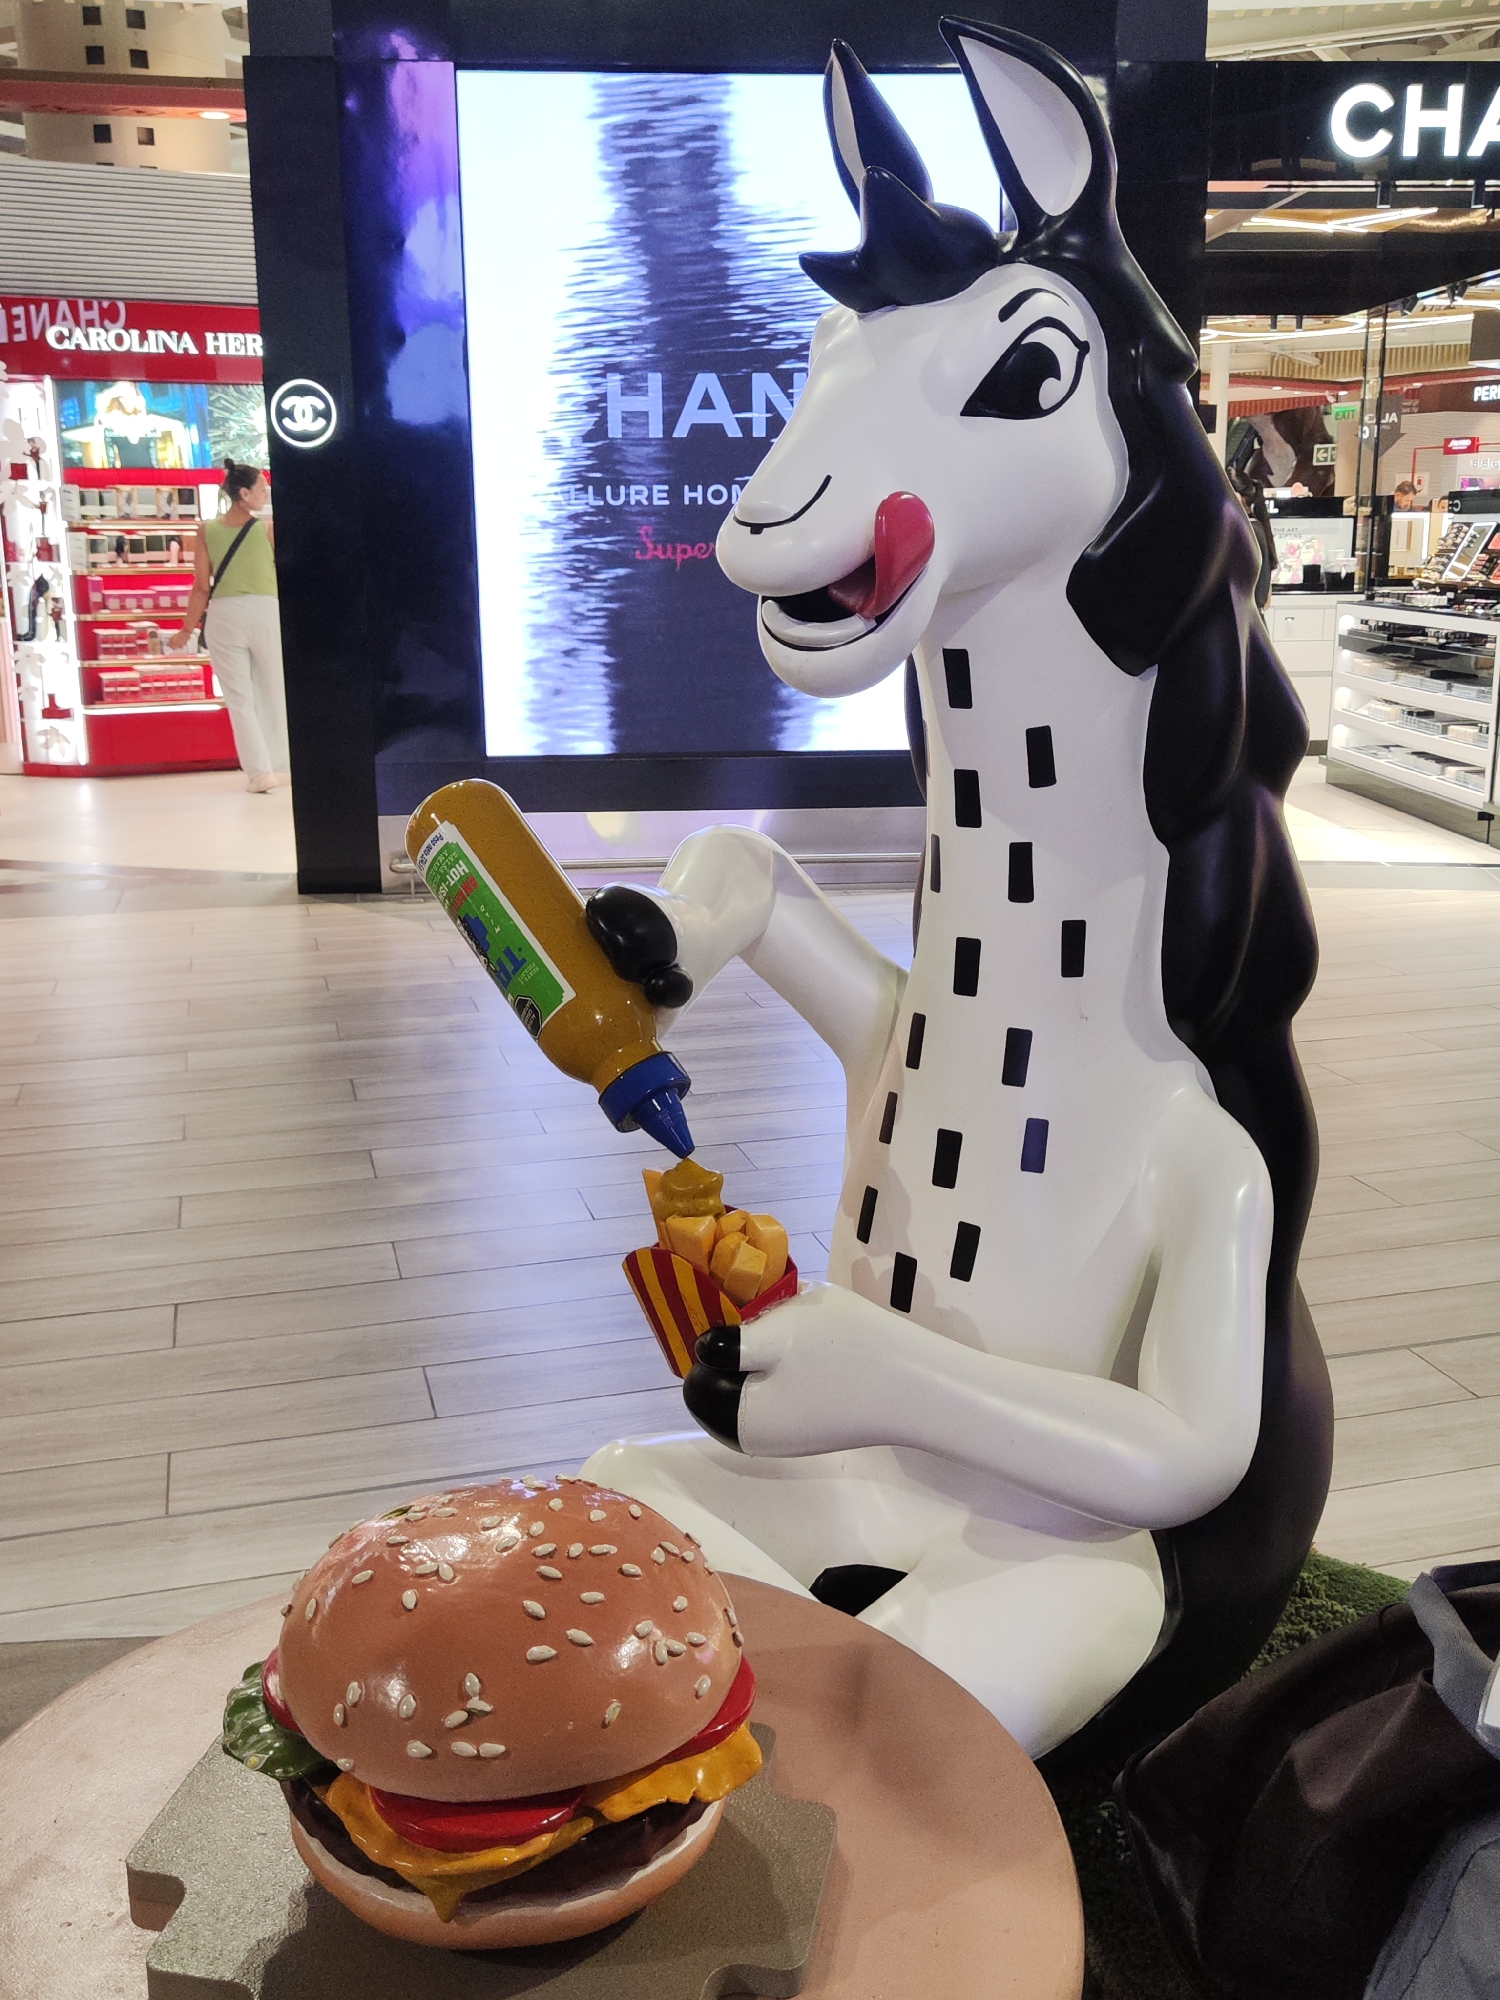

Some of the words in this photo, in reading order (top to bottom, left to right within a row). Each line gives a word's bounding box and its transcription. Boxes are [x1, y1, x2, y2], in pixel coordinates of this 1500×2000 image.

[46, 325, 200, 355] CAROLINA
[204, 331, 263, 357] HER
[1334, 408, 1356, 421] EXIT
[1364, 412, 1399, 424] CJA
[568, 484, 671, 506] LLURE
[429, 832, 444, 847] Peso
[480, 904, 501, 934] MILD
